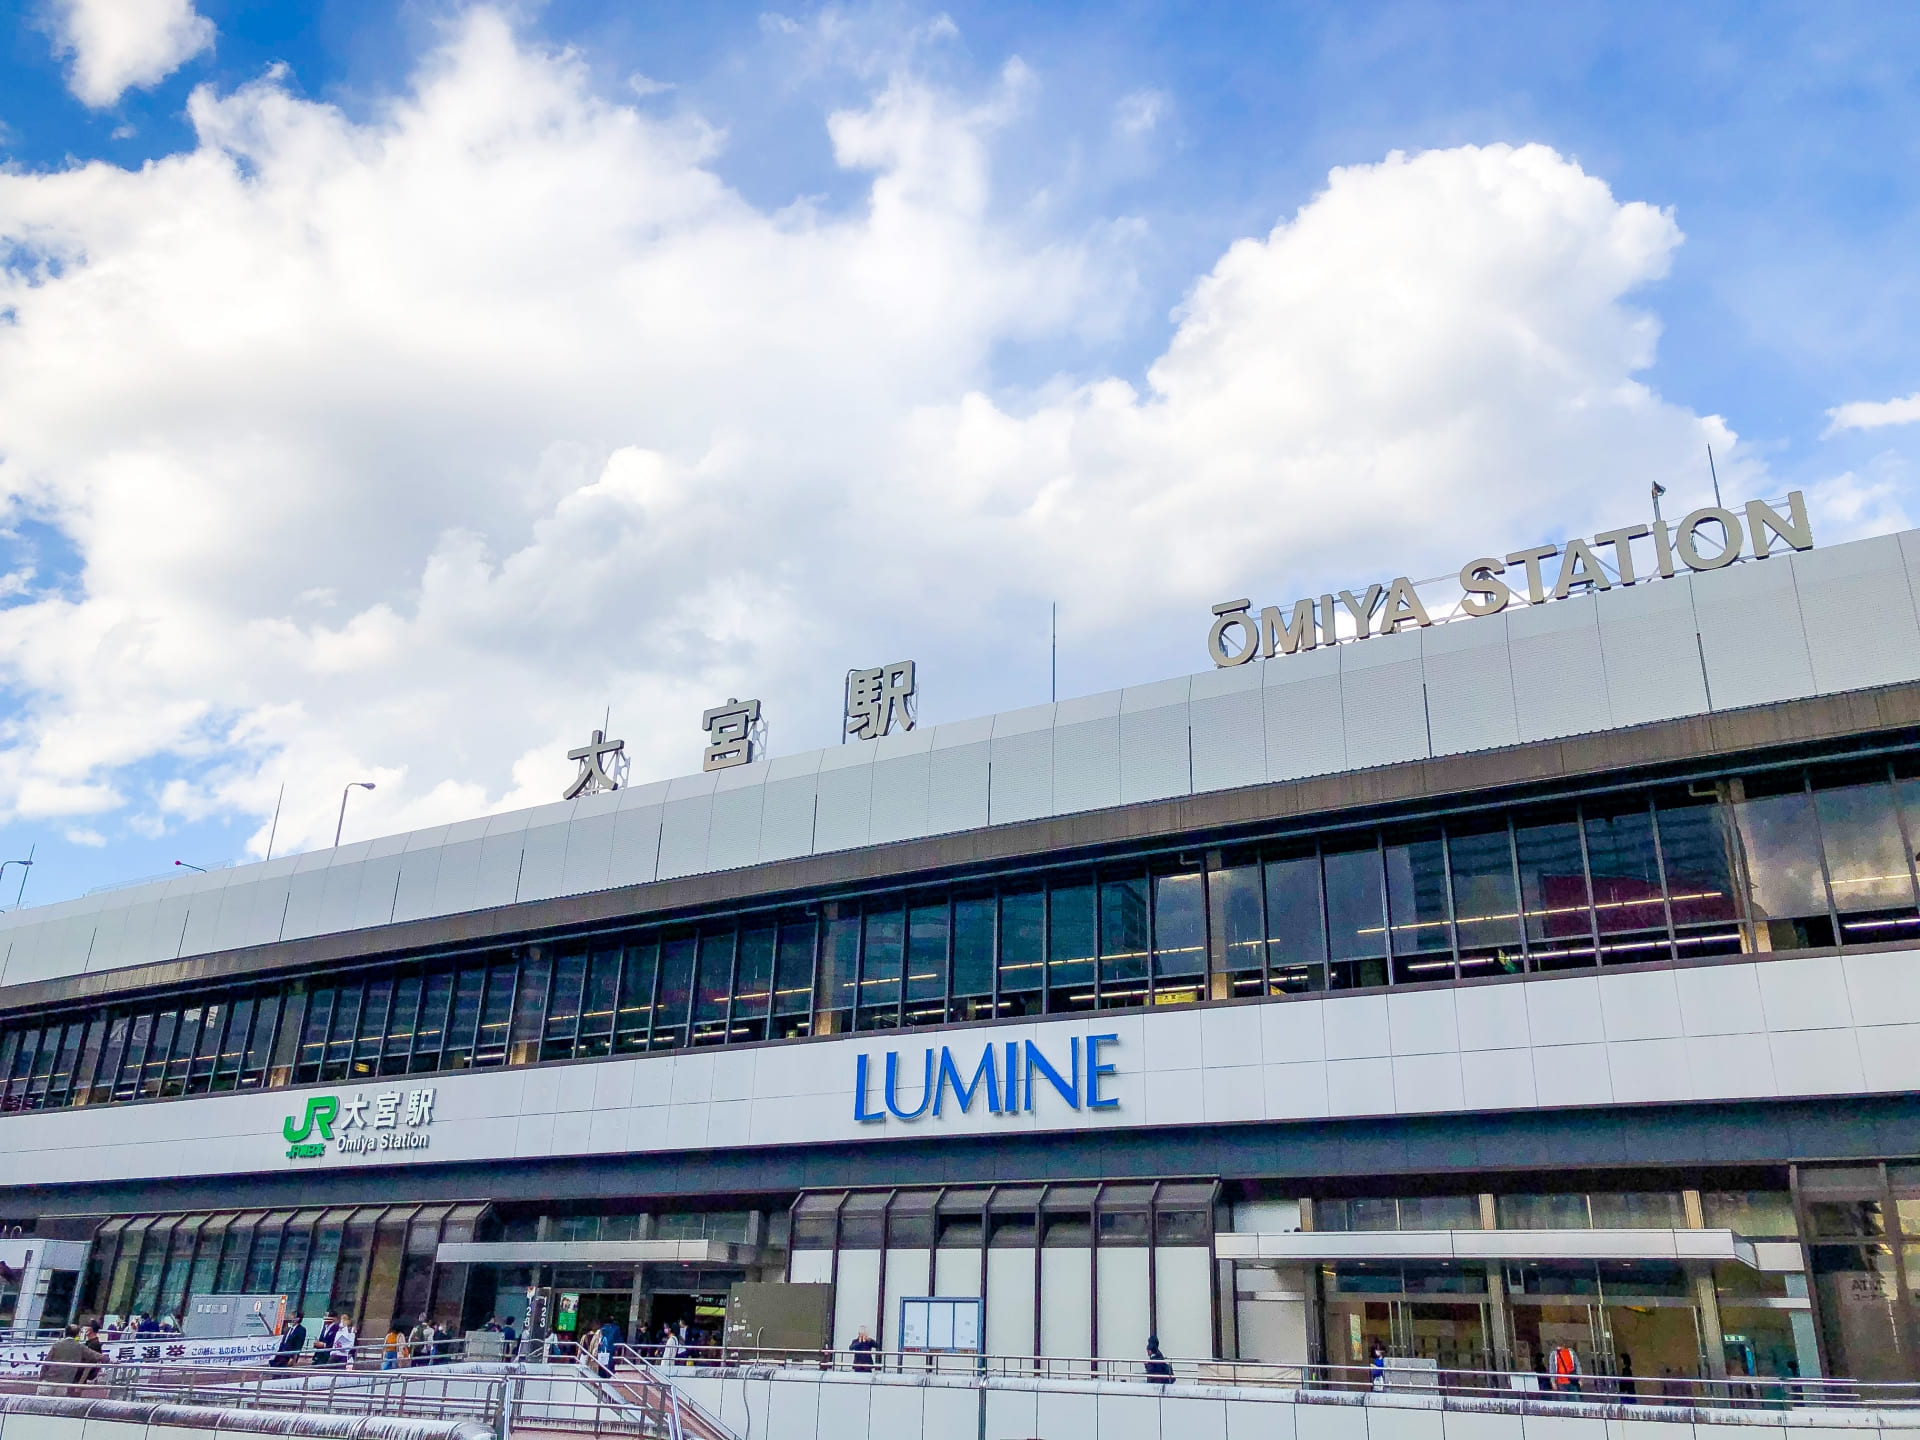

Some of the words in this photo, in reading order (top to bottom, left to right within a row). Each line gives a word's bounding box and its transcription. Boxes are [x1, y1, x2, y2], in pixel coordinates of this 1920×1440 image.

[1460, 490, 1813, 616] STATION
[563, 659, 915, 800] 大宮駅
[341, 1088, 436, 1130] 大宮駅
[854, 1033, 1119, 1121] LUMINE
[283, 1096, 339, 1142] JR
[379, 1132, 429, 1151] Station
